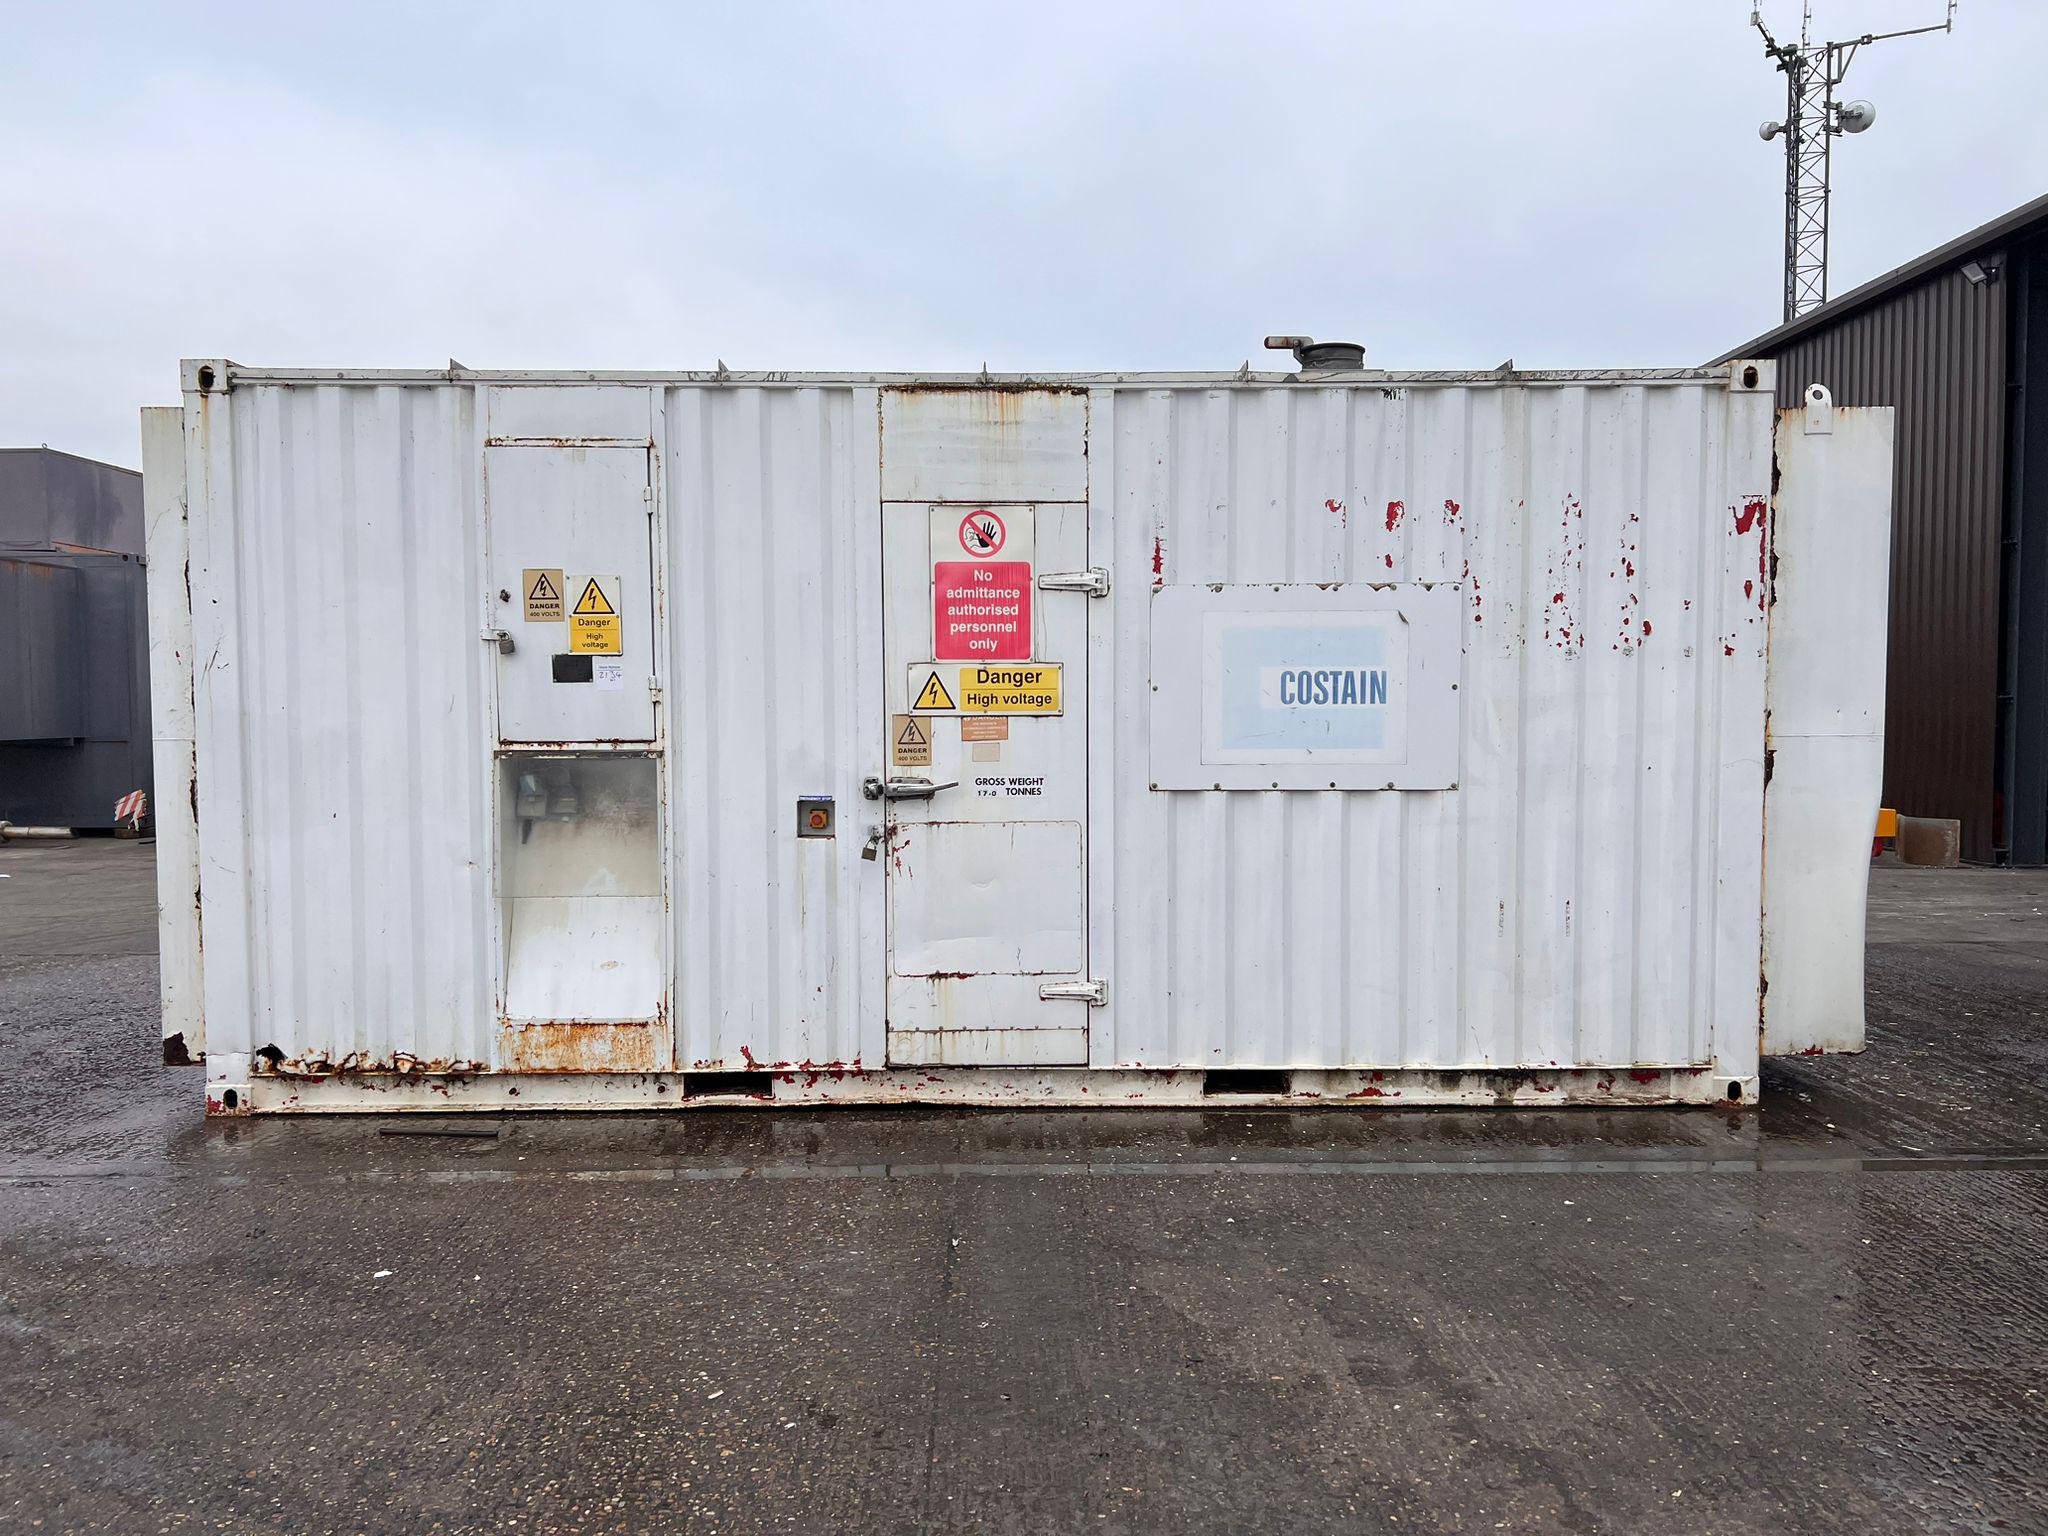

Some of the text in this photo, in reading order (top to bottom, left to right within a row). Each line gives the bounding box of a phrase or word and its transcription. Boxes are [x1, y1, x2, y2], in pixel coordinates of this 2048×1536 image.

[973, 569, 993, 581] No
[946, 587, 1021, 599] admittance
[947, 604, 1019, 616] authorised
[578, 618, 611, 627] Danger
[950, 621, 1017, 635] personnel
[581, 641, 608, 649] voltage
[969, 638, 998, 652] only
[977, 669, 1042, 687] Danger
[1280, 670, 1387, 705] COSTAIN
[967, 693, 1053, 707] High voltage
[975, 778, 1044, 786] GROSS WEIGHT
[1005, 787, 1042, 796] TONNES
